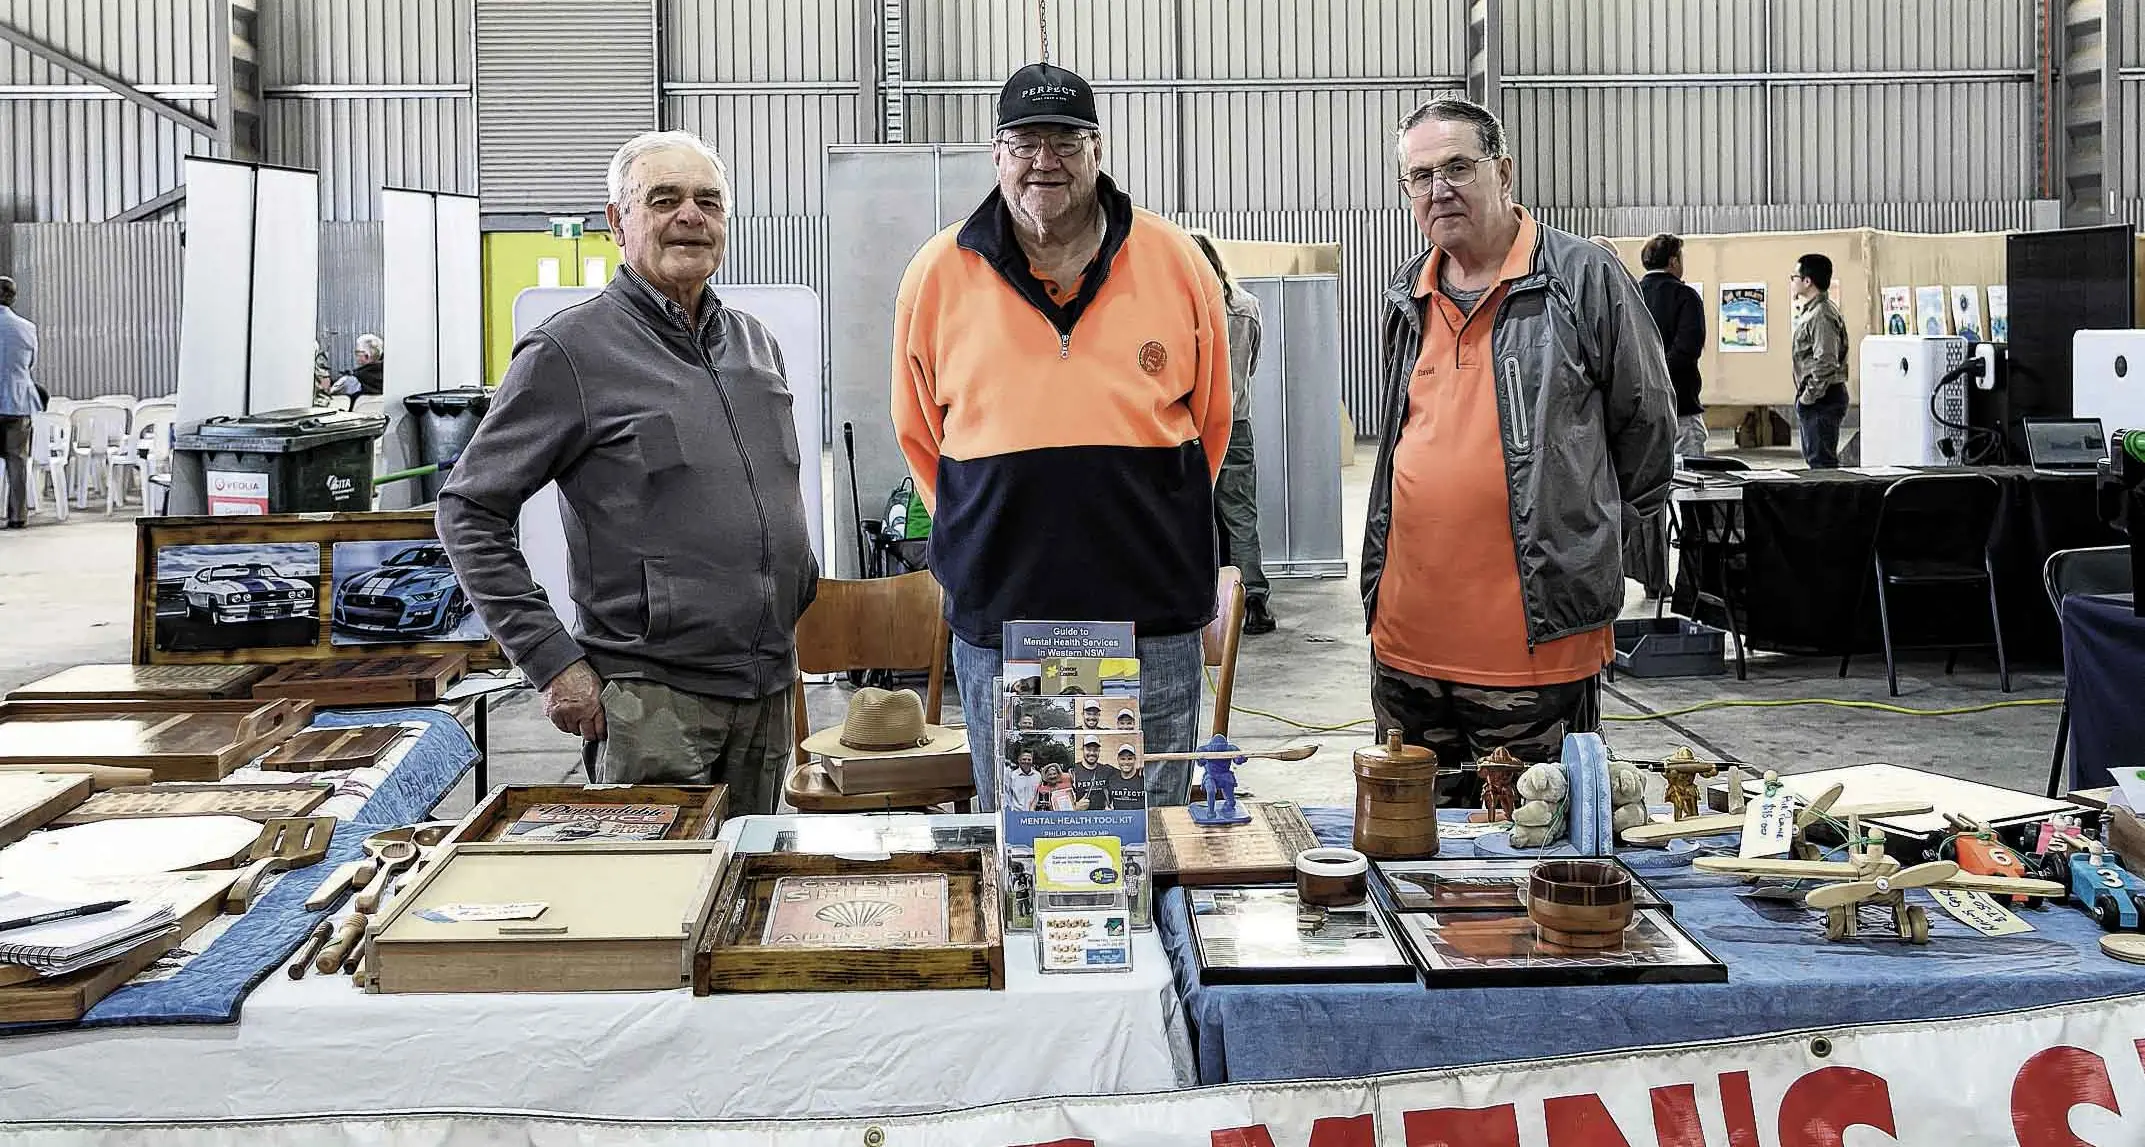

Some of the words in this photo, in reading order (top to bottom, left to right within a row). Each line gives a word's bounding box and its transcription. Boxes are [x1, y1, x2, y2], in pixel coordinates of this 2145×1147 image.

[1021, 85, 1077, 99] PERFECT
[1417, 366, 1435, 376] David
[226, 482, 260, 490] VEOLIA
[1053, 627, 1078, 636] Guide
[1080, 627, 1089, 636] to
[1023, 638, 1052, 646] Mental
[1053, 638, 1080, 646] Health
[1082, 639, 1119, 647] Services
[1037, 648, 1046, 657] in
[1047, 649, 1082, 657] Western
[1084, 649, 1105, 657] NSW
[539, 804, 666, 816] Dependable
[1057, 817, 1093, 825] HEALTH
[1094, 816, 1118, 824] TOOL
[1120, 815, 1133, 824] KIT
[1988, 848, 2013, 866] 6
[2096, 868, 2125, 888] 3
[784, 887, 938, 902] SHELL
[775, 931, 870, 944] AUTO
[883, 930, 937, 941] OIL
